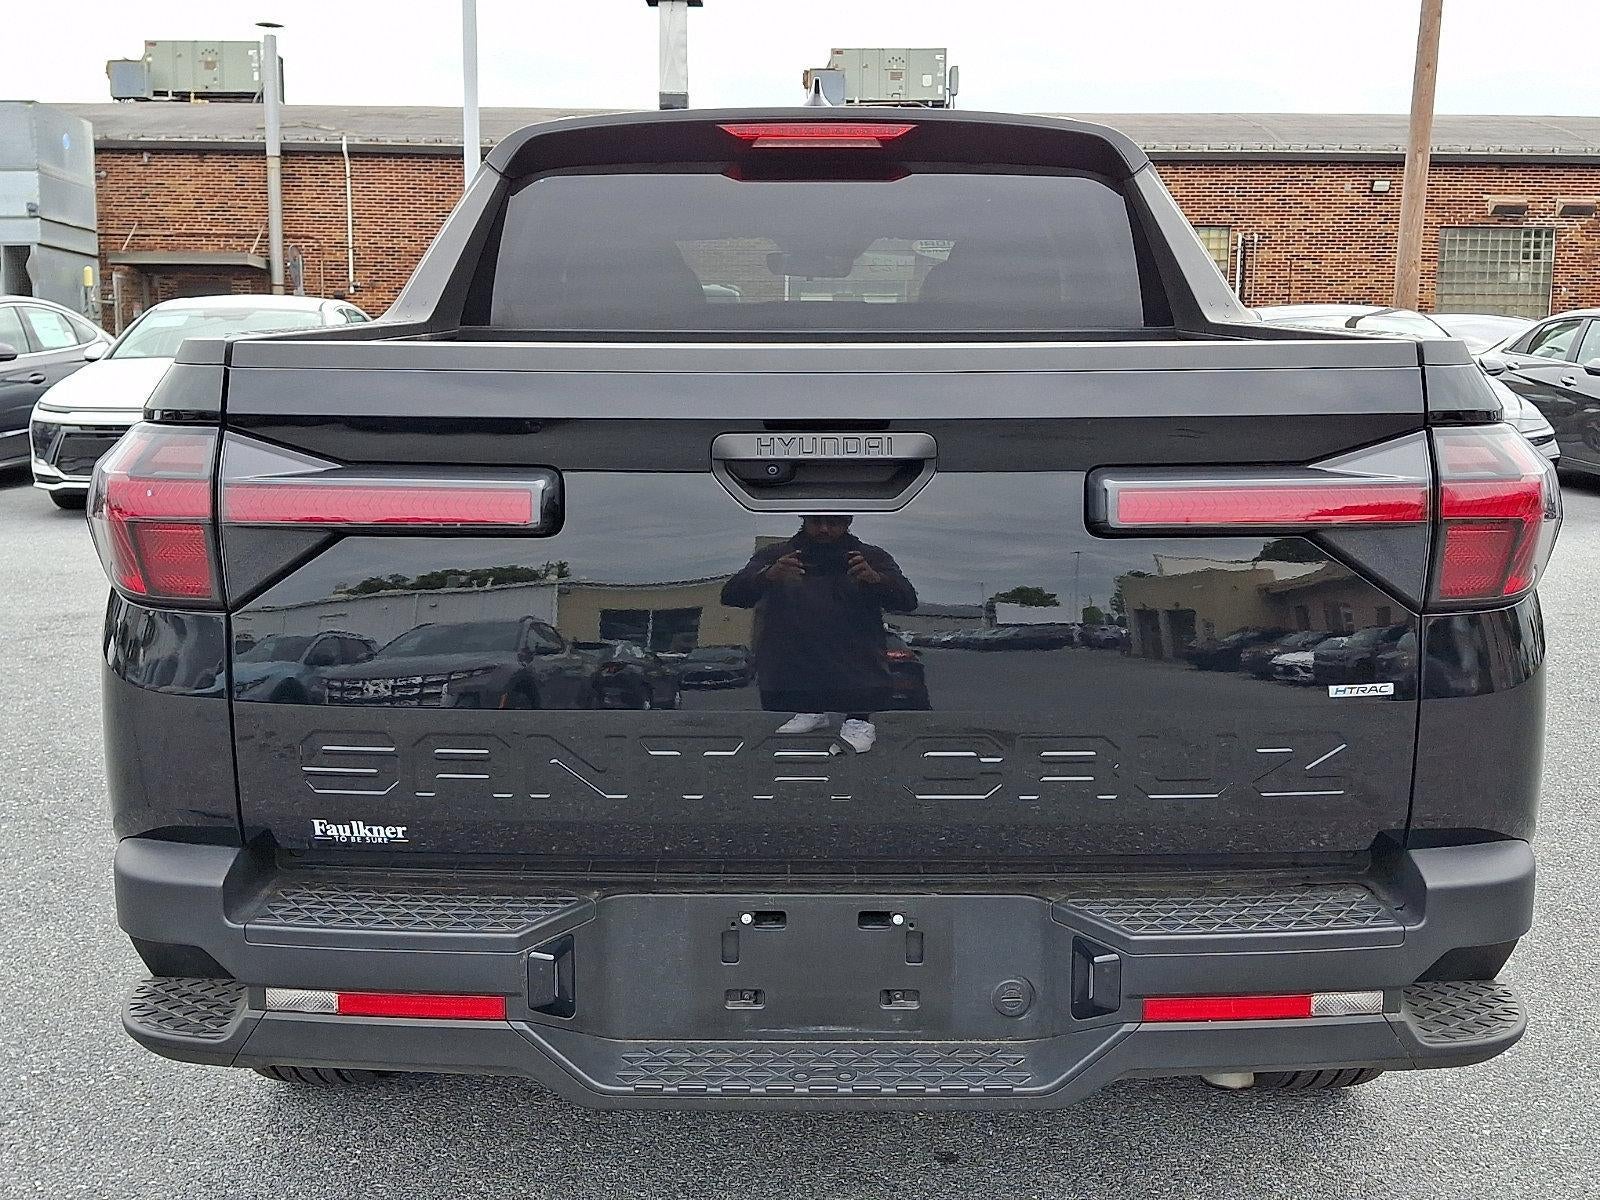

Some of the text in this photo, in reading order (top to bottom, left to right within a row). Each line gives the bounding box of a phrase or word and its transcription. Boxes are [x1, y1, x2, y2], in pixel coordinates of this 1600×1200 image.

[756, 436, 893, 456] HYUNDAI
[1334, 684, 1390, 696] HTRAC
[300, 730, 1348, 800] SANTA CRUZ
[310, 819, 408, 838] Faulkner
[333, 835, 348, 843] TO
[365, 836, 389, 844] SURE
